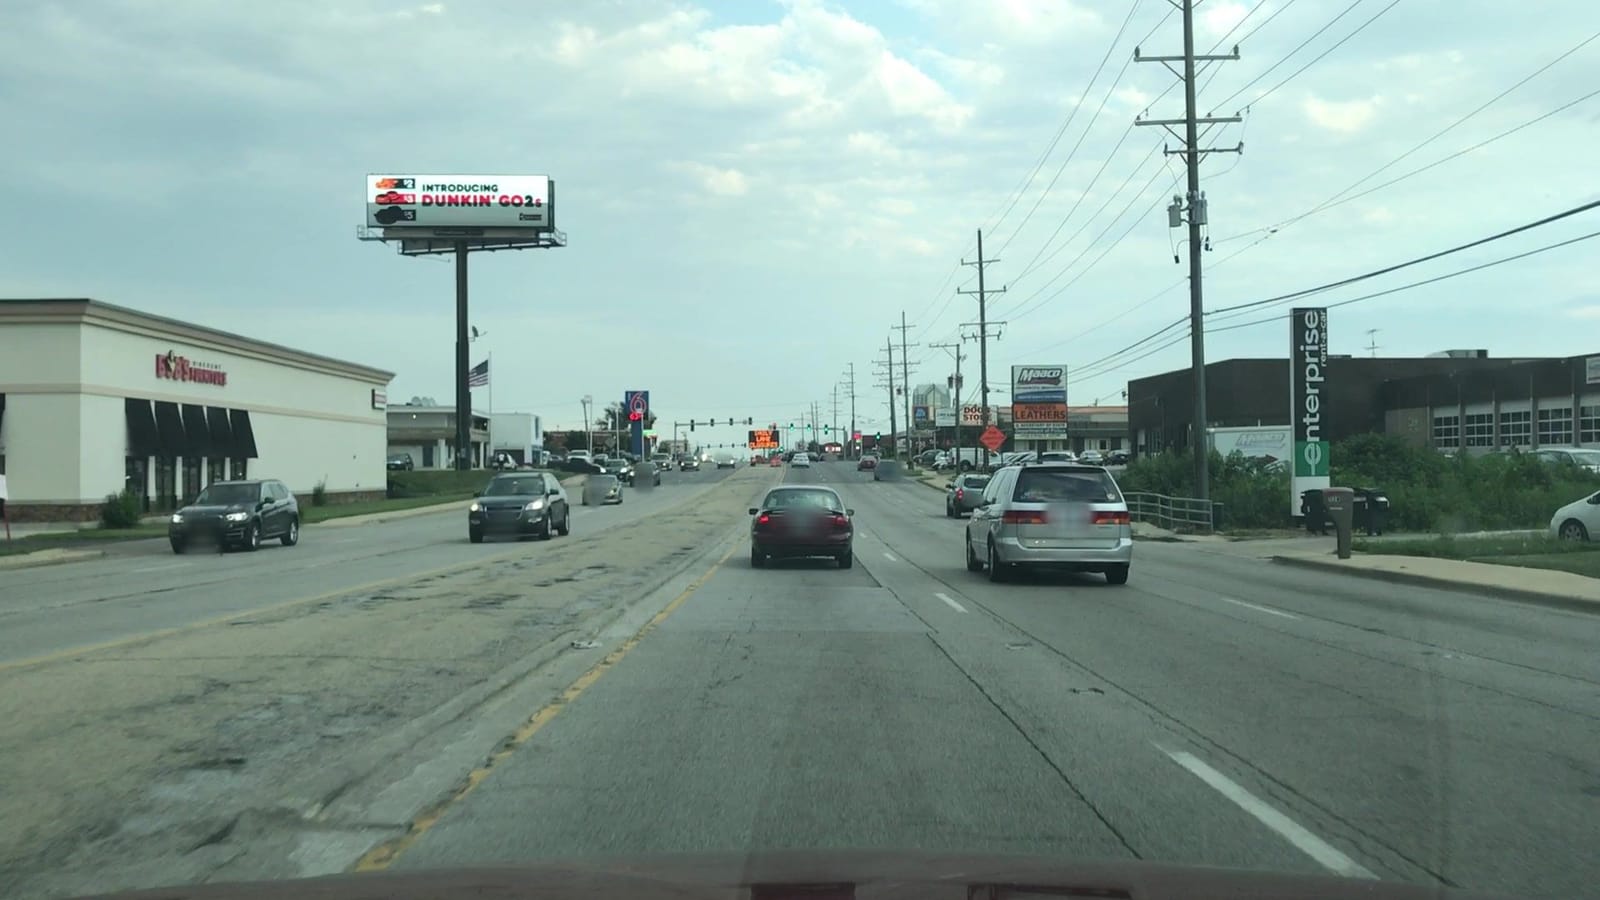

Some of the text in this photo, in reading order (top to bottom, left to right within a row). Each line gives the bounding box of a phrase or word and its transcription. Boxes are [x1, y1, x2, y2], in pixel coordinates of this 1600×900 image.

[422, 184, 498, 193] INTRODUCING
[421, 194, 496, 207] DUNKIN'
[1300, 310, 1324, 476] enterprise
[629, 391, 647, 414] 6
[964, 406, 990, 414] DOO
[1015, 410, 1066, 420] LEATHERS
